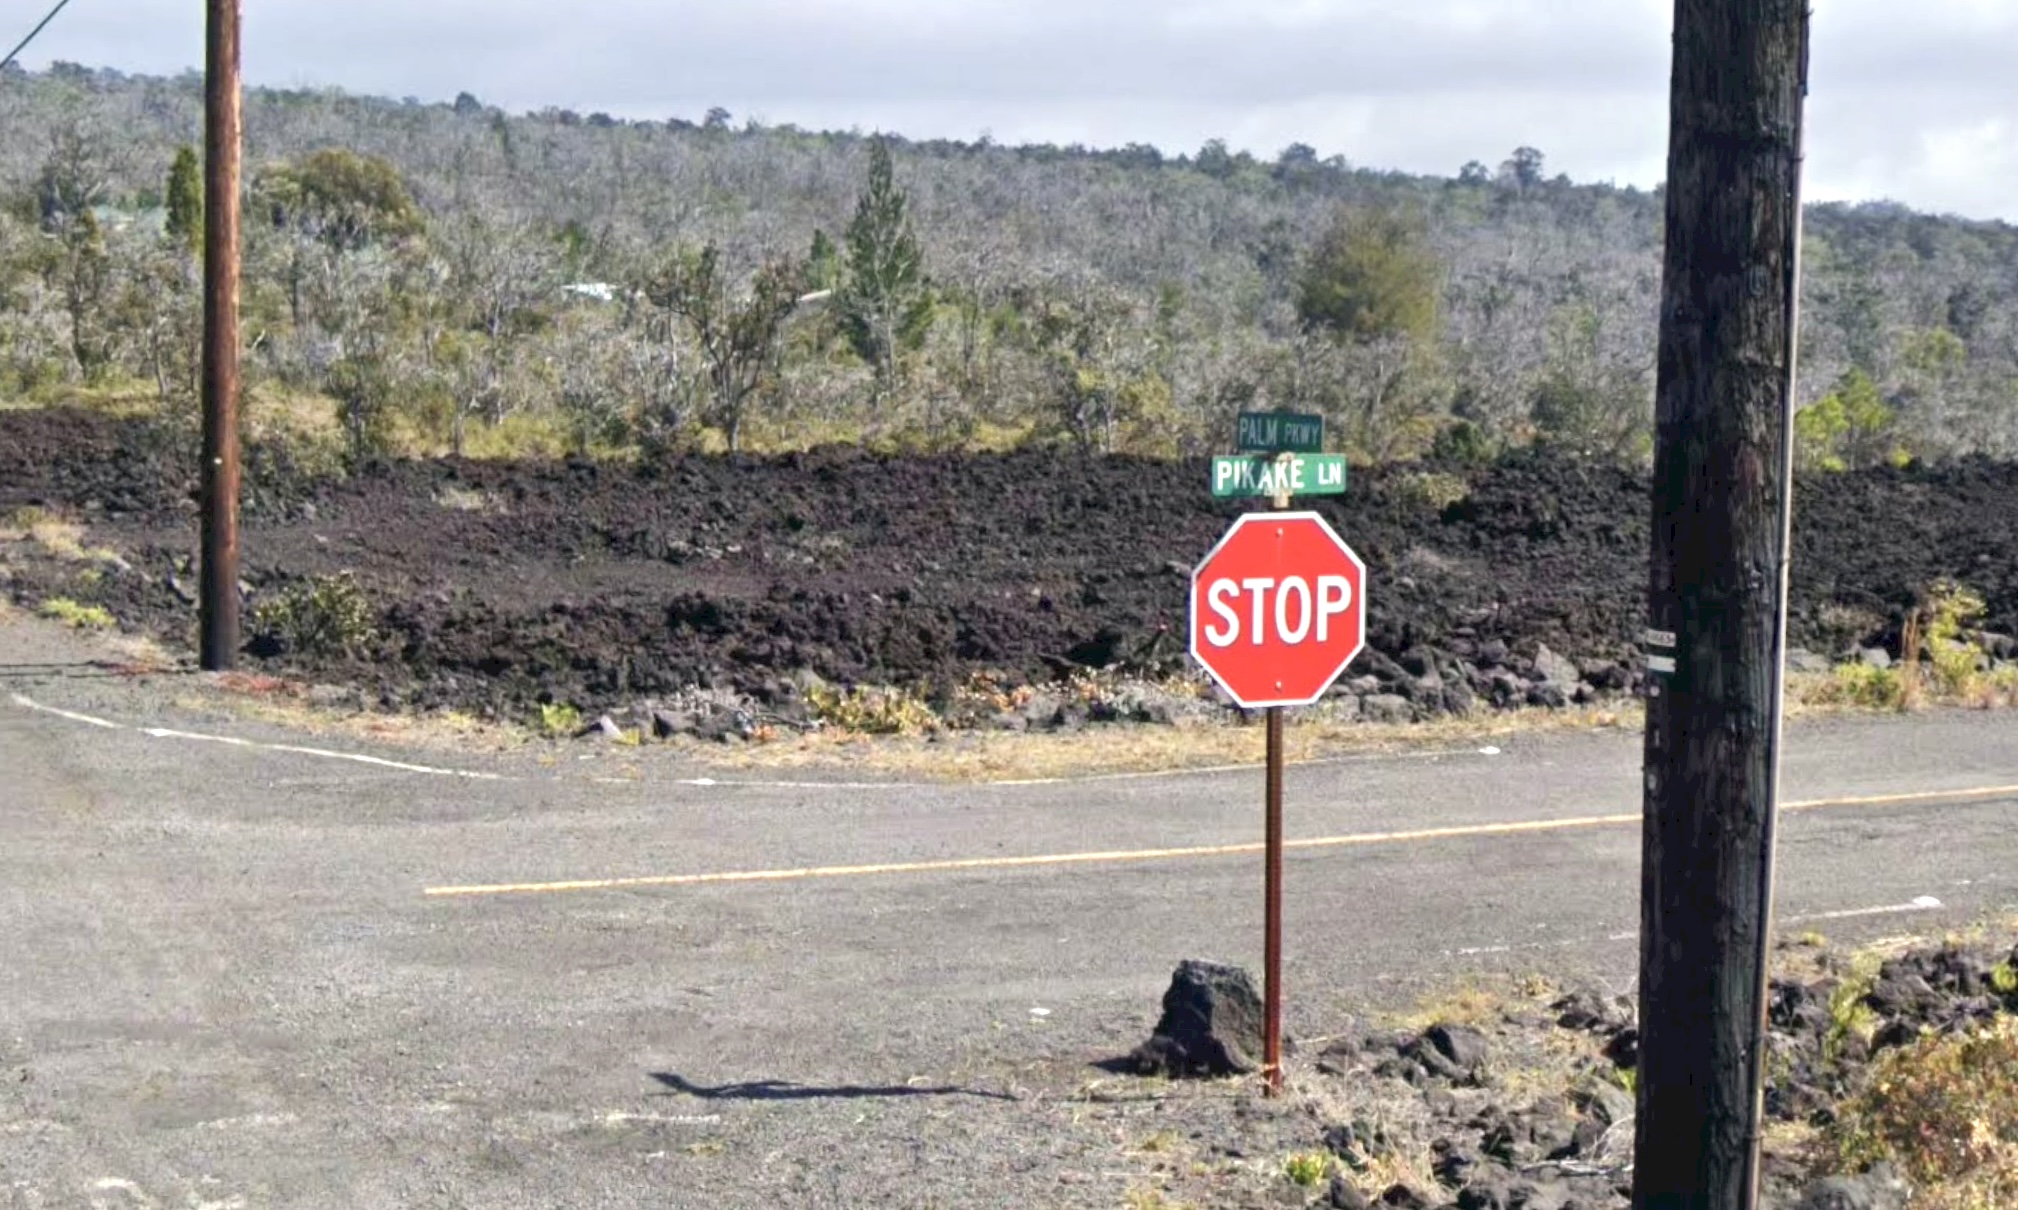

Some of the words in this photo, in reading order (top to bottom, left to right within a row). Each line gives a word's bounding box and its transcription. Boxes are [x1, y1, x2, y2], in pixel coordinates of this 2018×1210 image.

[1239, 417, 1278, 445] PALM
[1284, 422, 1320, 445] PKWY
[1217, 460, 1305, 490] PIKAKE
[1318, 462, 1341, 485] LN
[1205, 575, 1352, 647] STOP
